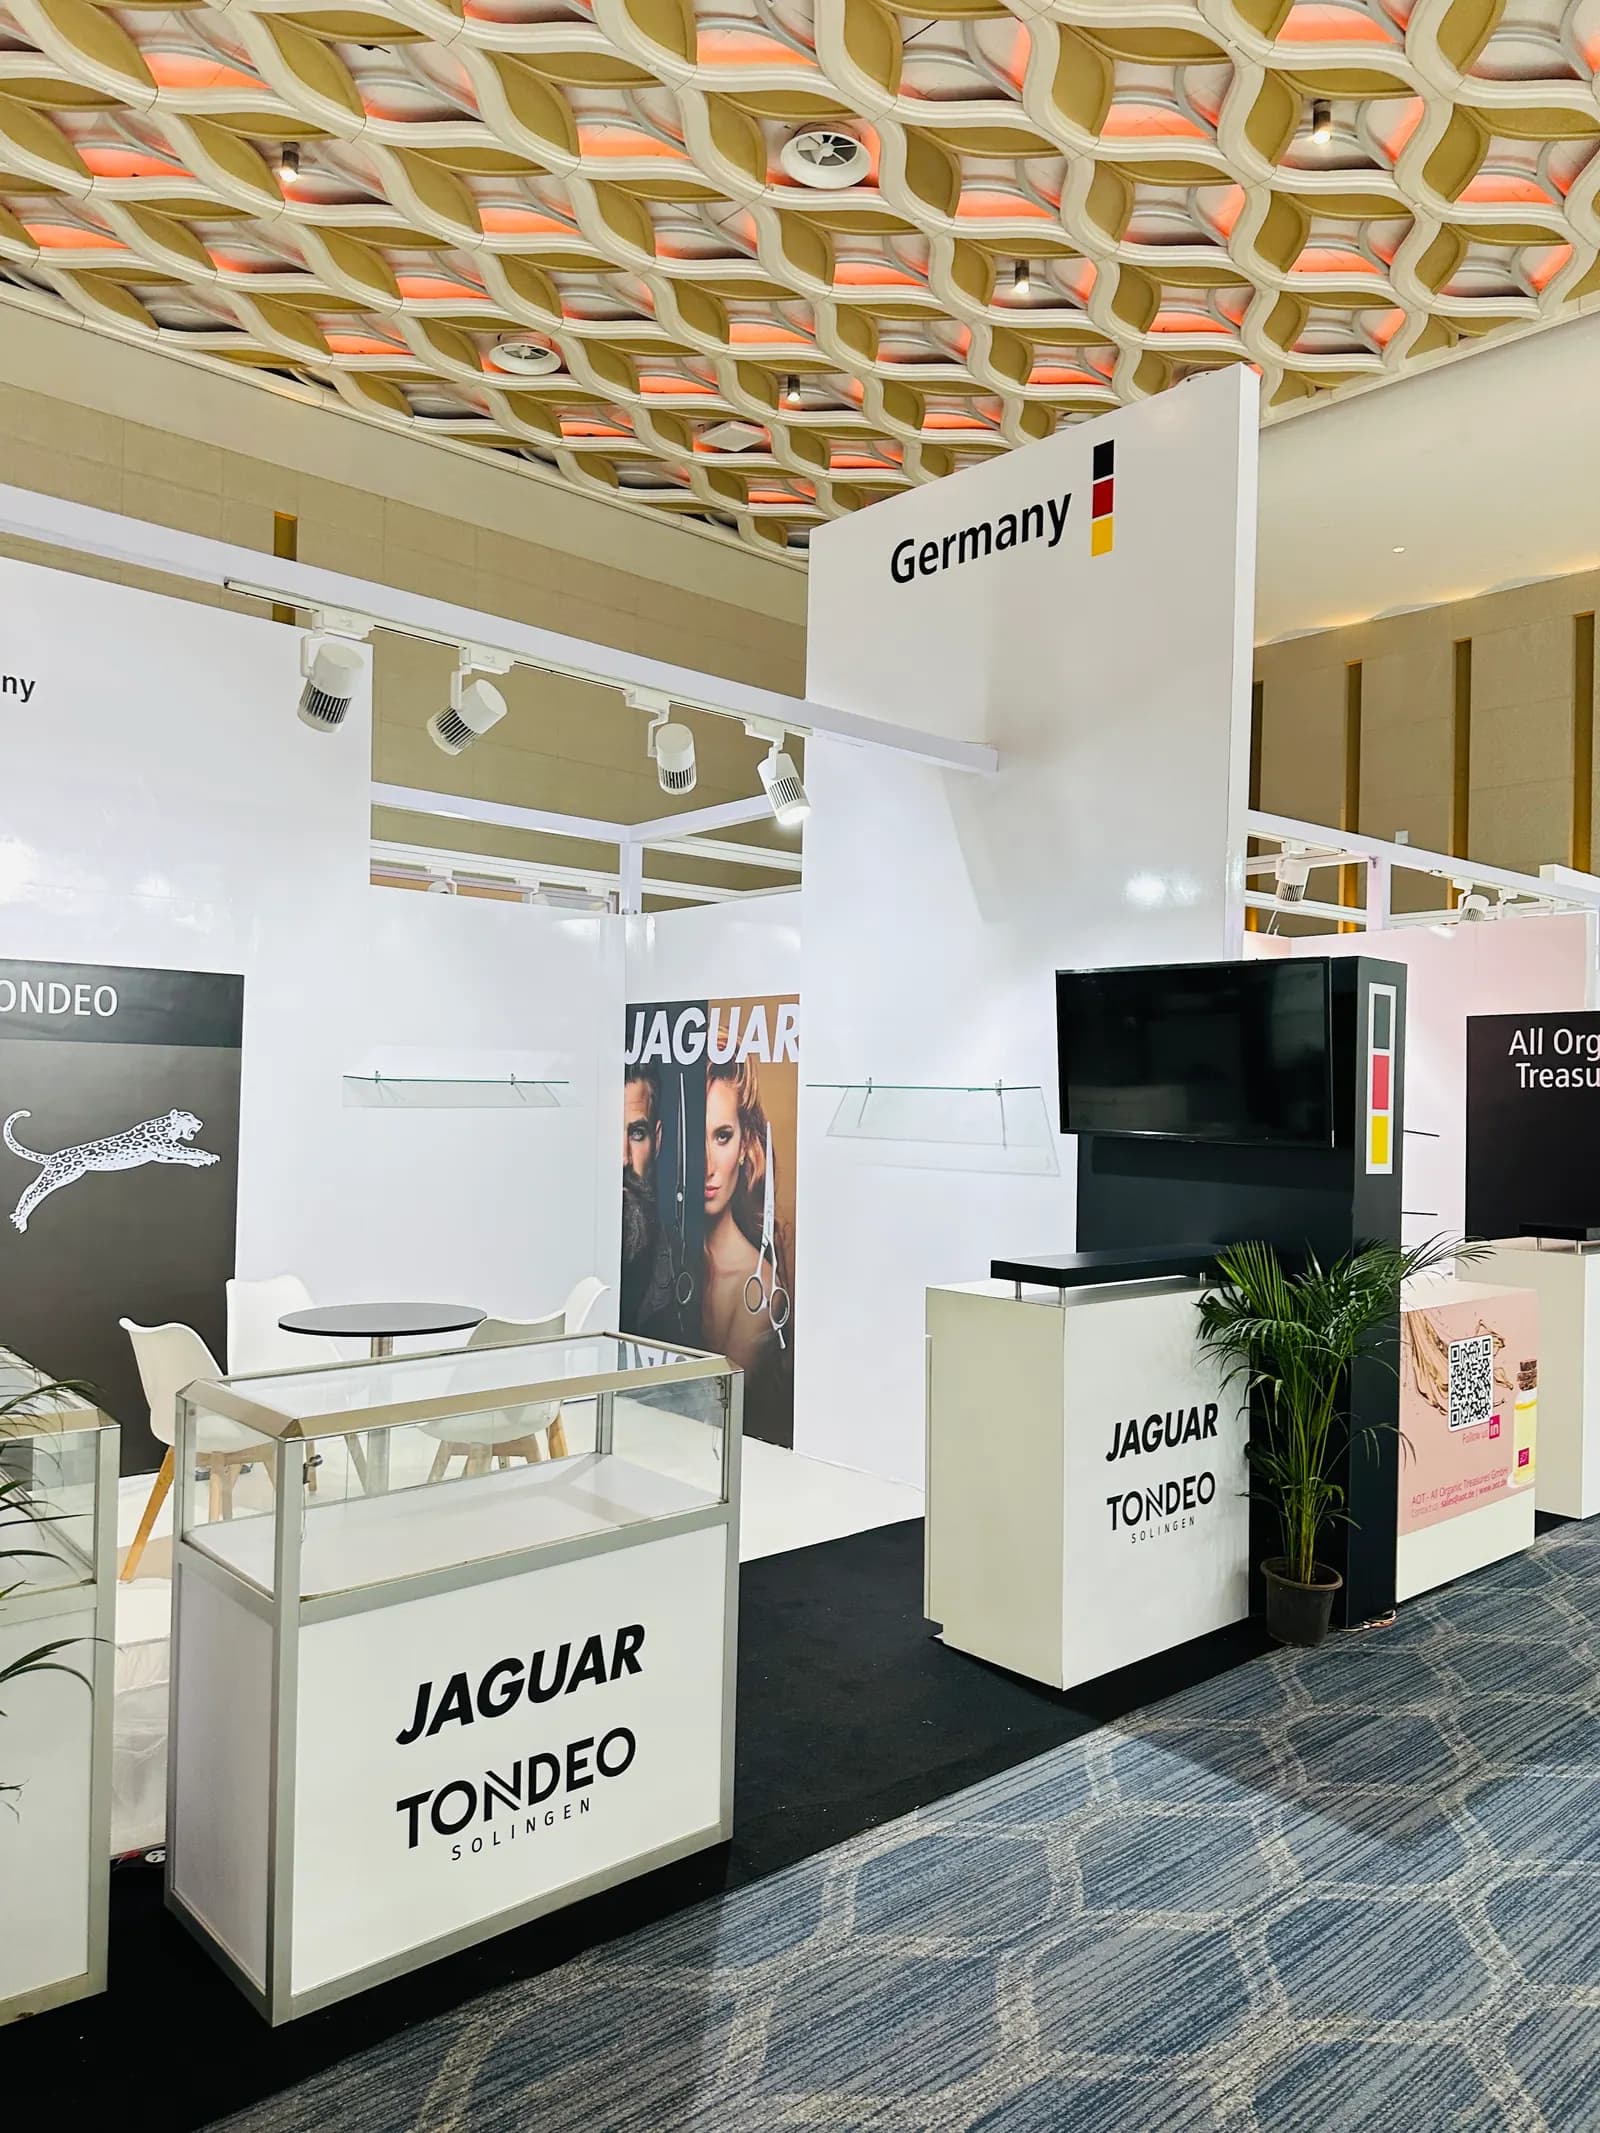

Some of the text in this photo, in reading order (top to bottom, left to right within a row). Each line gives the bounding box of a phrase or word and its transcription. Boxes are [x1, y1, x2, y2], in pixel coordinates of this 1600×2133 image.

[890, 492, 1072, 584] Germany
[2, 675, 36, 703] ny
[0, 979, 118, 1017] ONDEO
[624, 1003, 800, 1065] JAGUAR
[1508, 1027, 1600, 1062] All Org
[1515, 1062, 1600, 1089] Treasu
[1105, 1402, 1218, 1462] JAGUAR
[1106, 1471, 1216, 1531] TONDEO
[1131, 1515, 1195, 1544] SOLINGEN
[395, 1623, 645, 1745] JAGUAR
[396, 1727, 636, 1849] TONDEO
[451, 1797, 590, 1861] SOLINGEN
